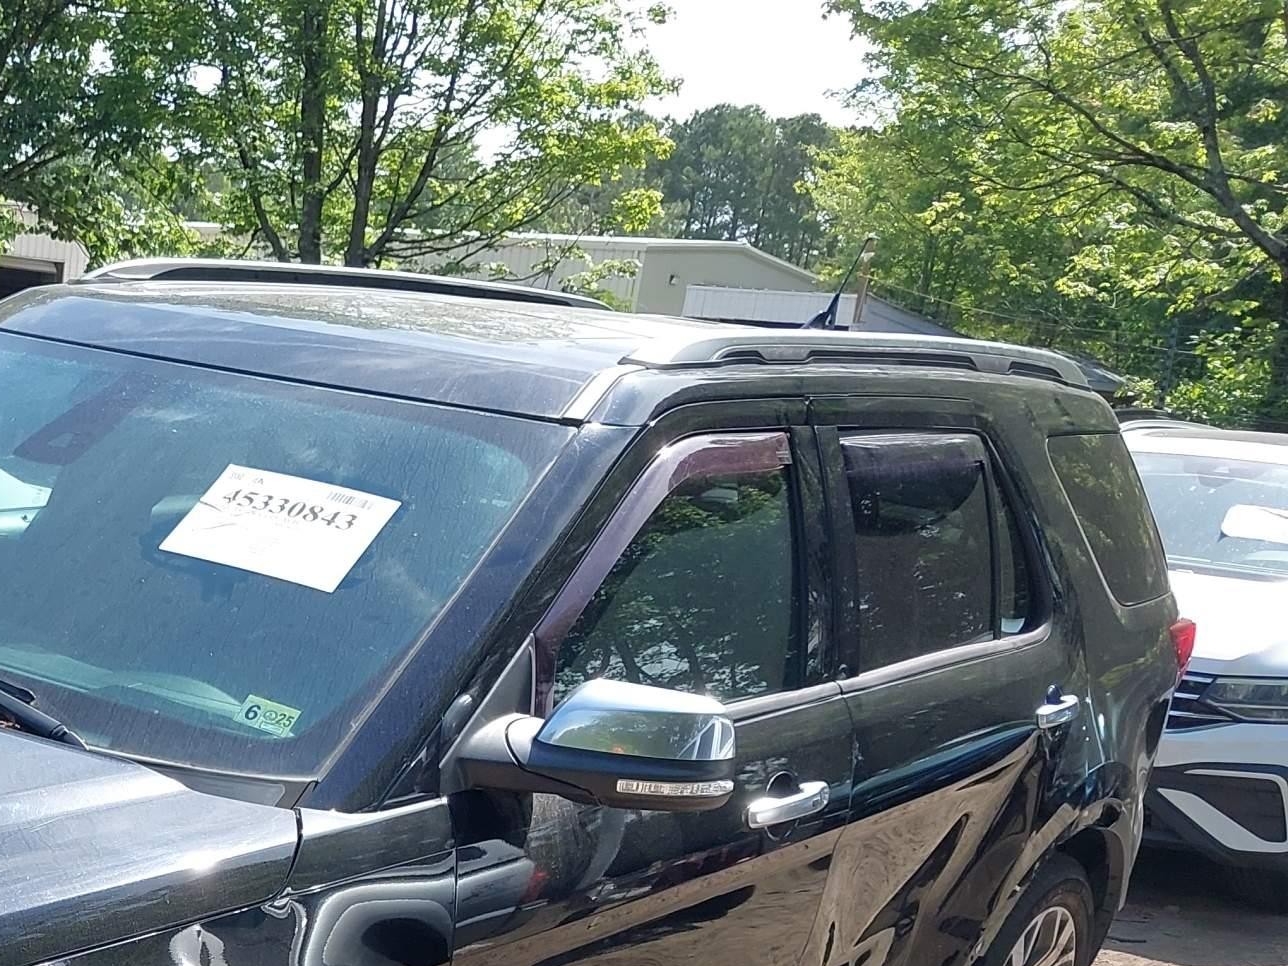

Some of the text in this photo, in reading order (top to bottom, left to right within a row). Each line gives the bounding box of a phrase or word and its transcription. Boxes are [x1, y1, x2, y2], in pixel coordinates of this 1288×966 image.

[223, 488, 358, 531] 45330843
[244, 704, 295, 728] 6 25
